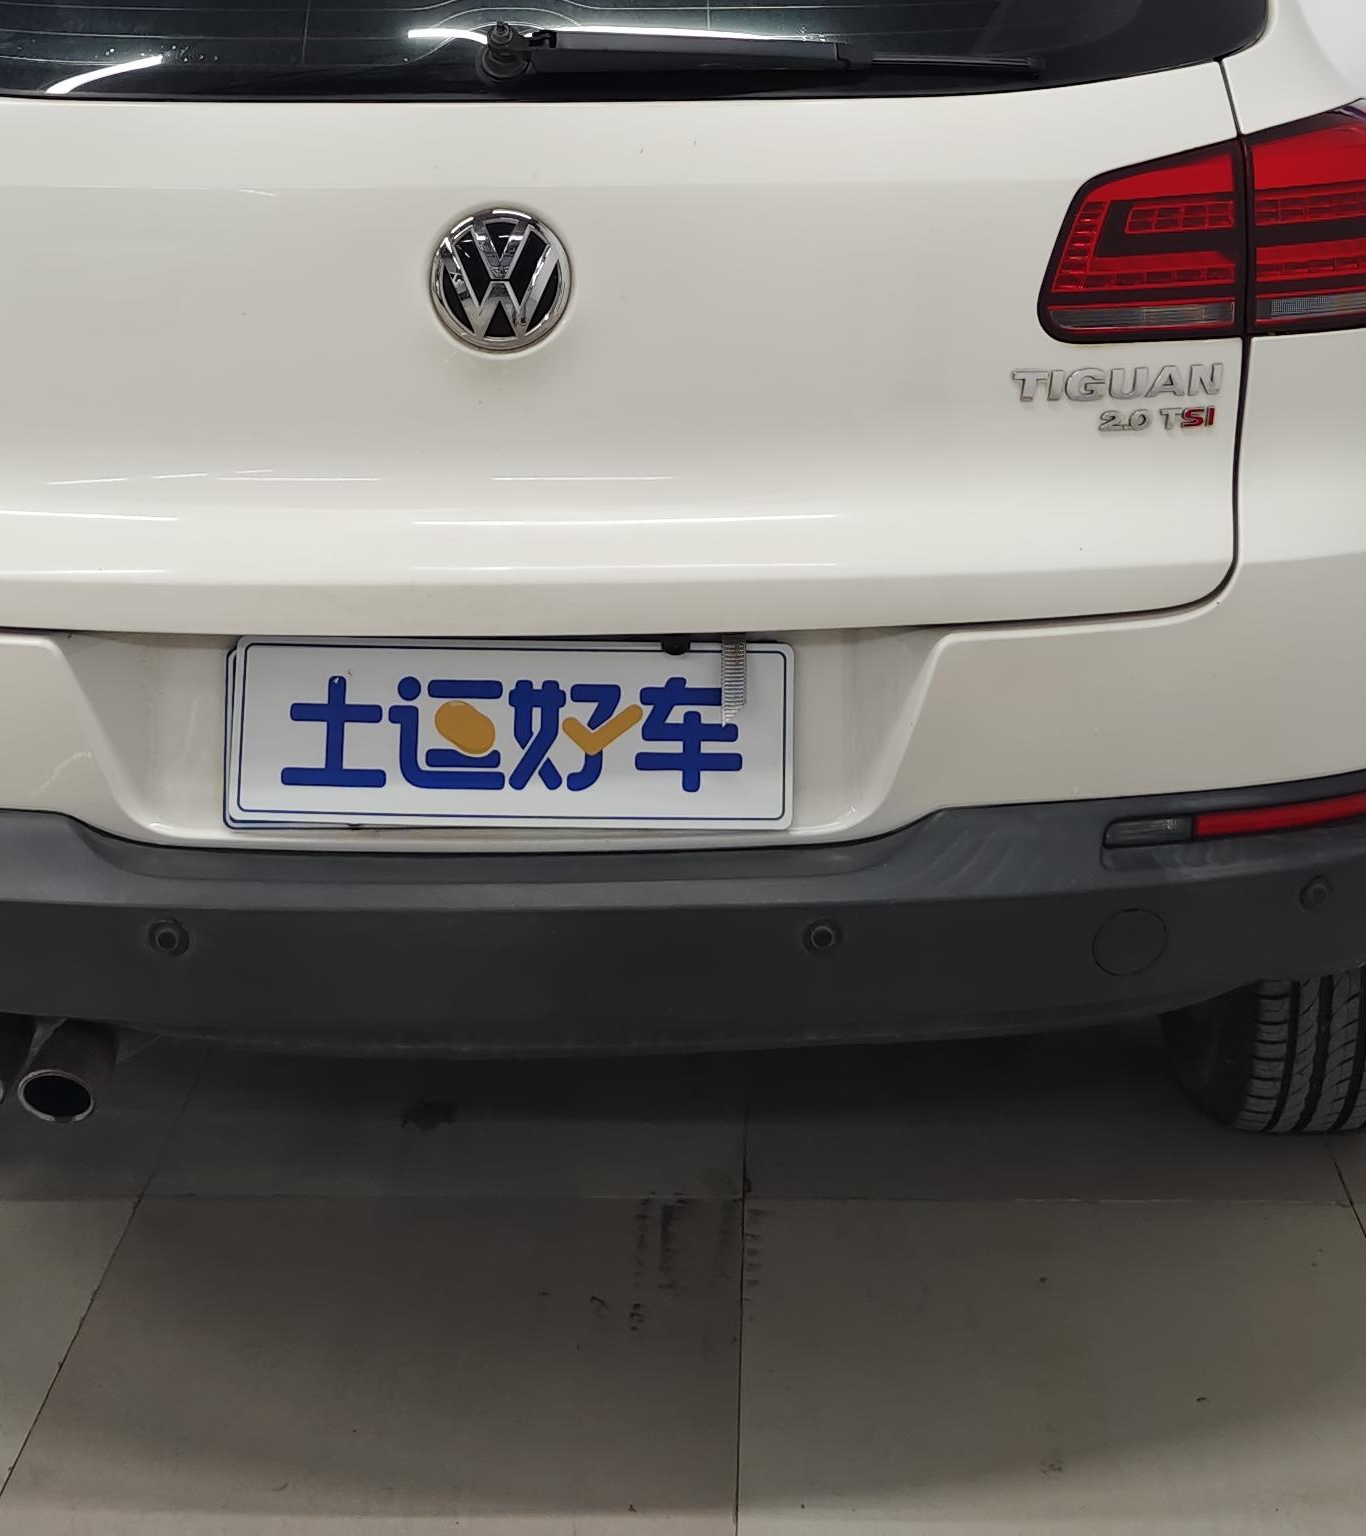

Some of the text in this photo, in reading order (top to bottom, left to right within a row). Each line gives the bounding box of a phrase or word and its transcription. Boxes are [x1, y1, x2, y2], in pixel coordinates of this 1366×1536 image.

[1011, 362, 1224, 402] TIGUAN
[1098, 406, 1216, 432] 2.0 TSI
